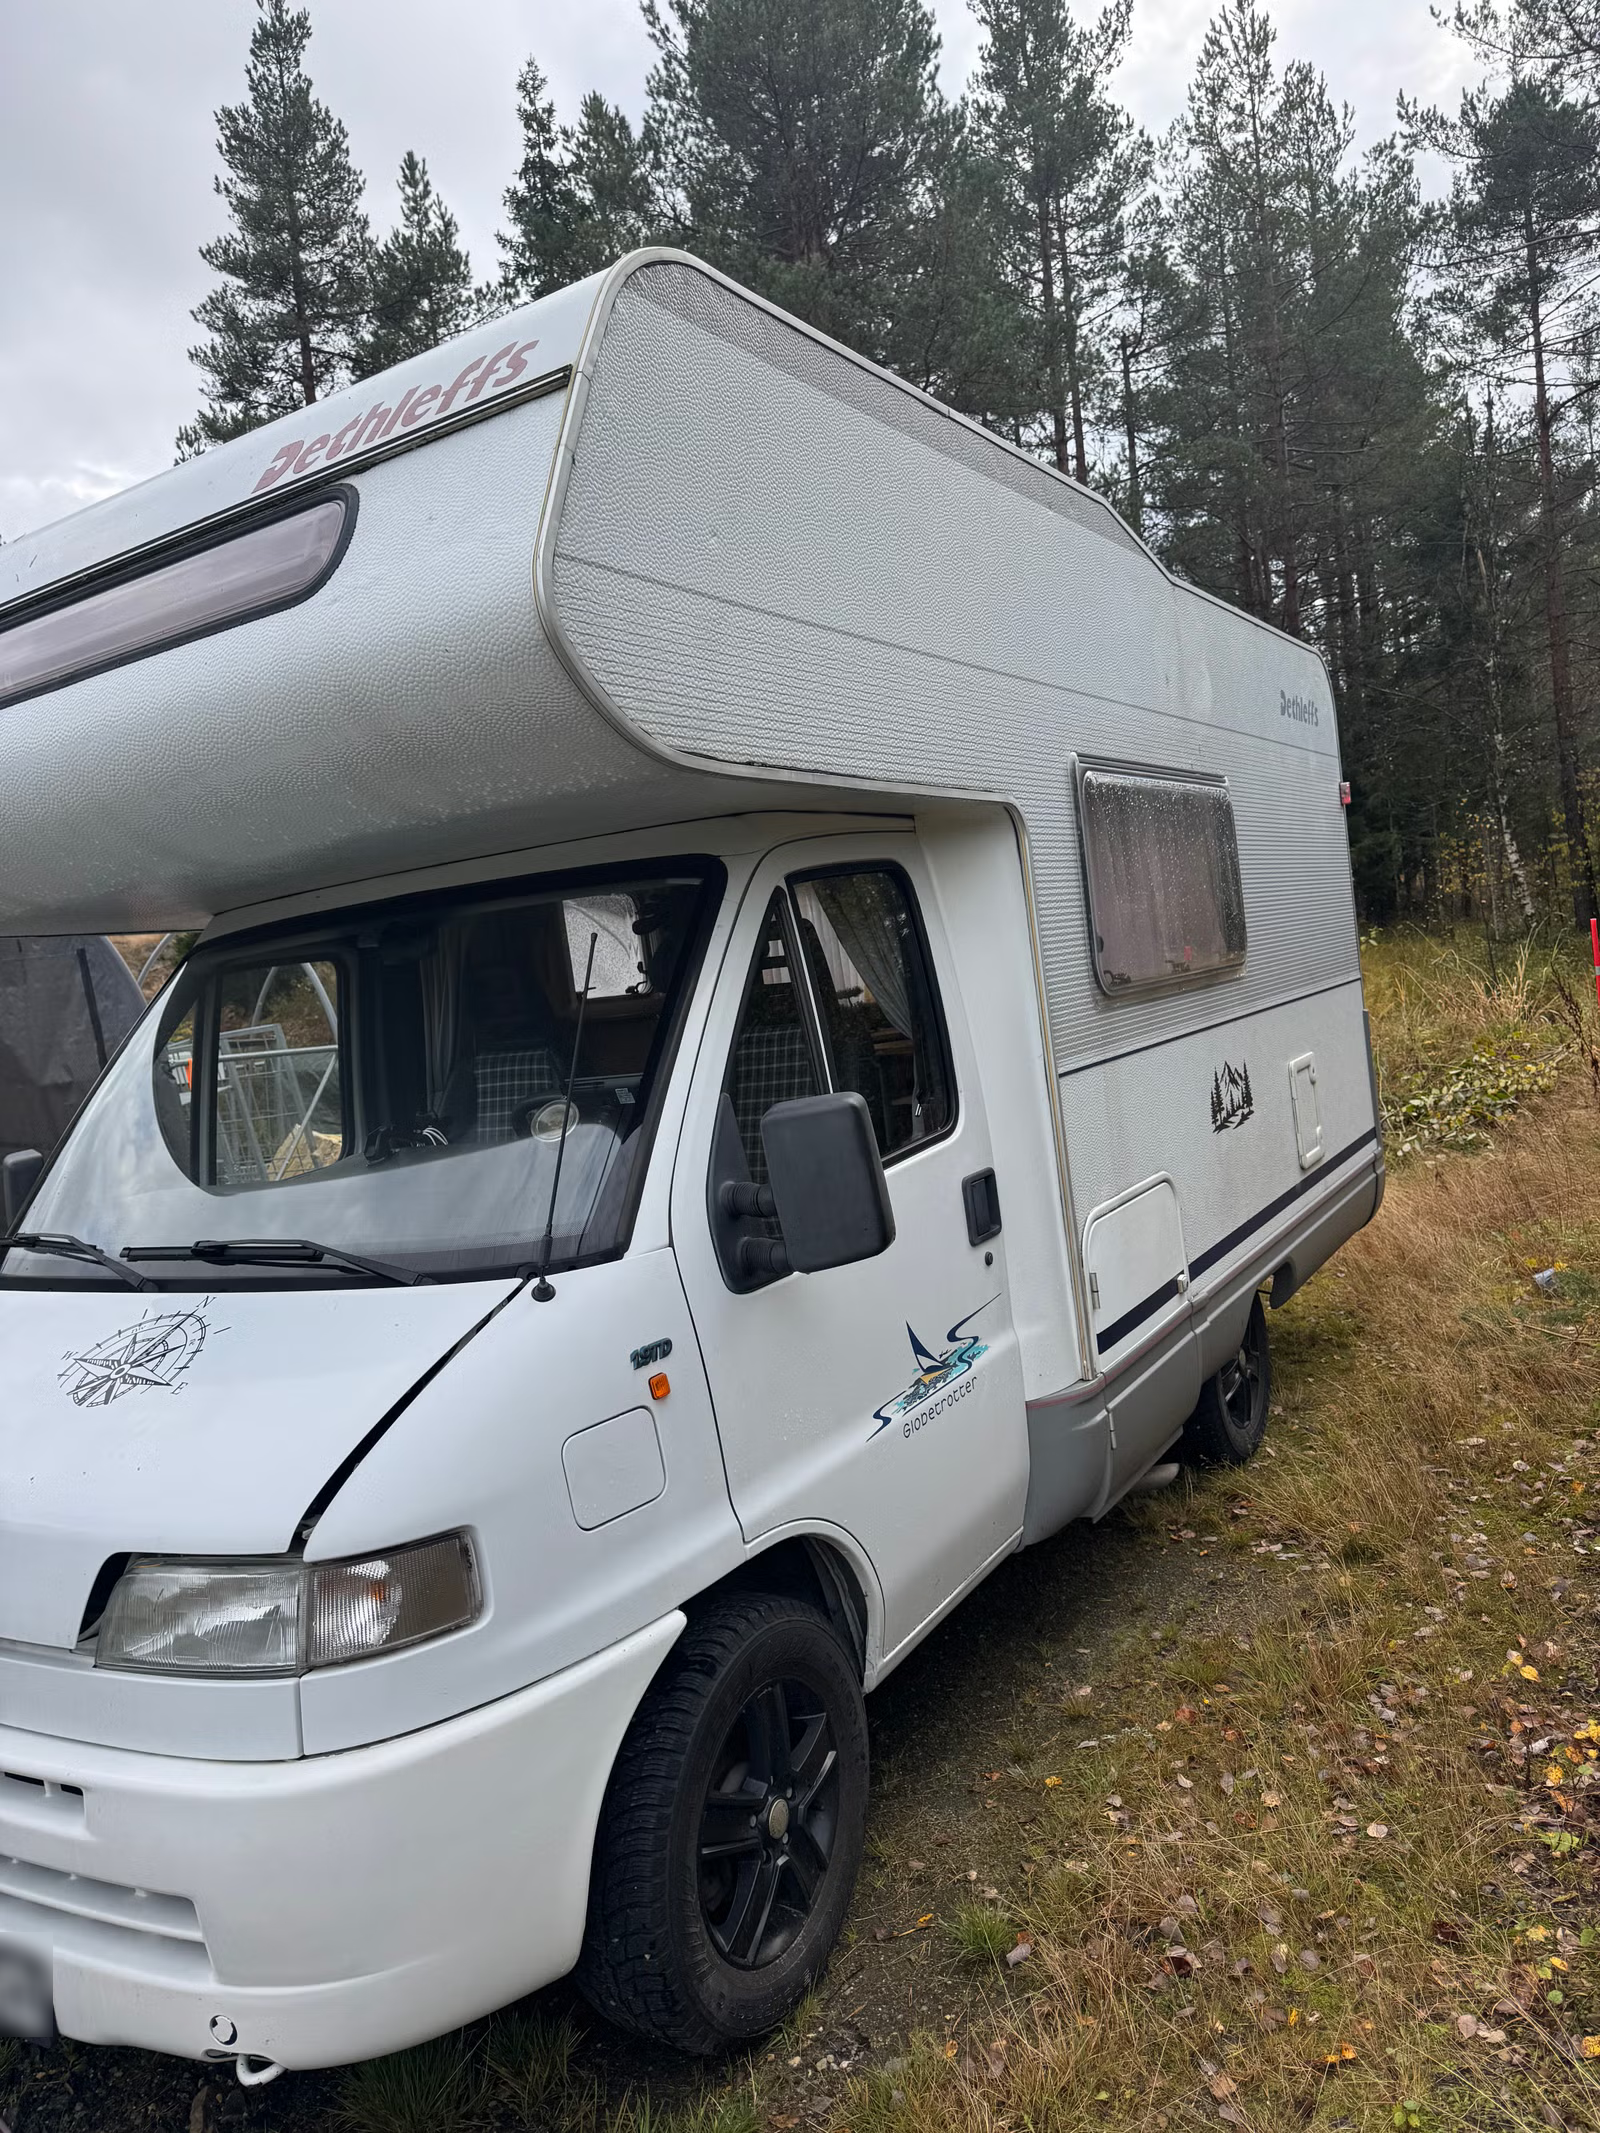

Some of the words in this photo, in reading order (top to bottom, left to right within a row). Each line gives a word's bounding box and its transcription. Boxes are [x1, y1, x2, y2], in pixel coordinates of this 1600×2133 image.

[251, 340, 540, 494] Dethleffs
[1280, 689, 1319, 728] Dethleffs
[903, 1376, 978, 1438] Globetrotter
